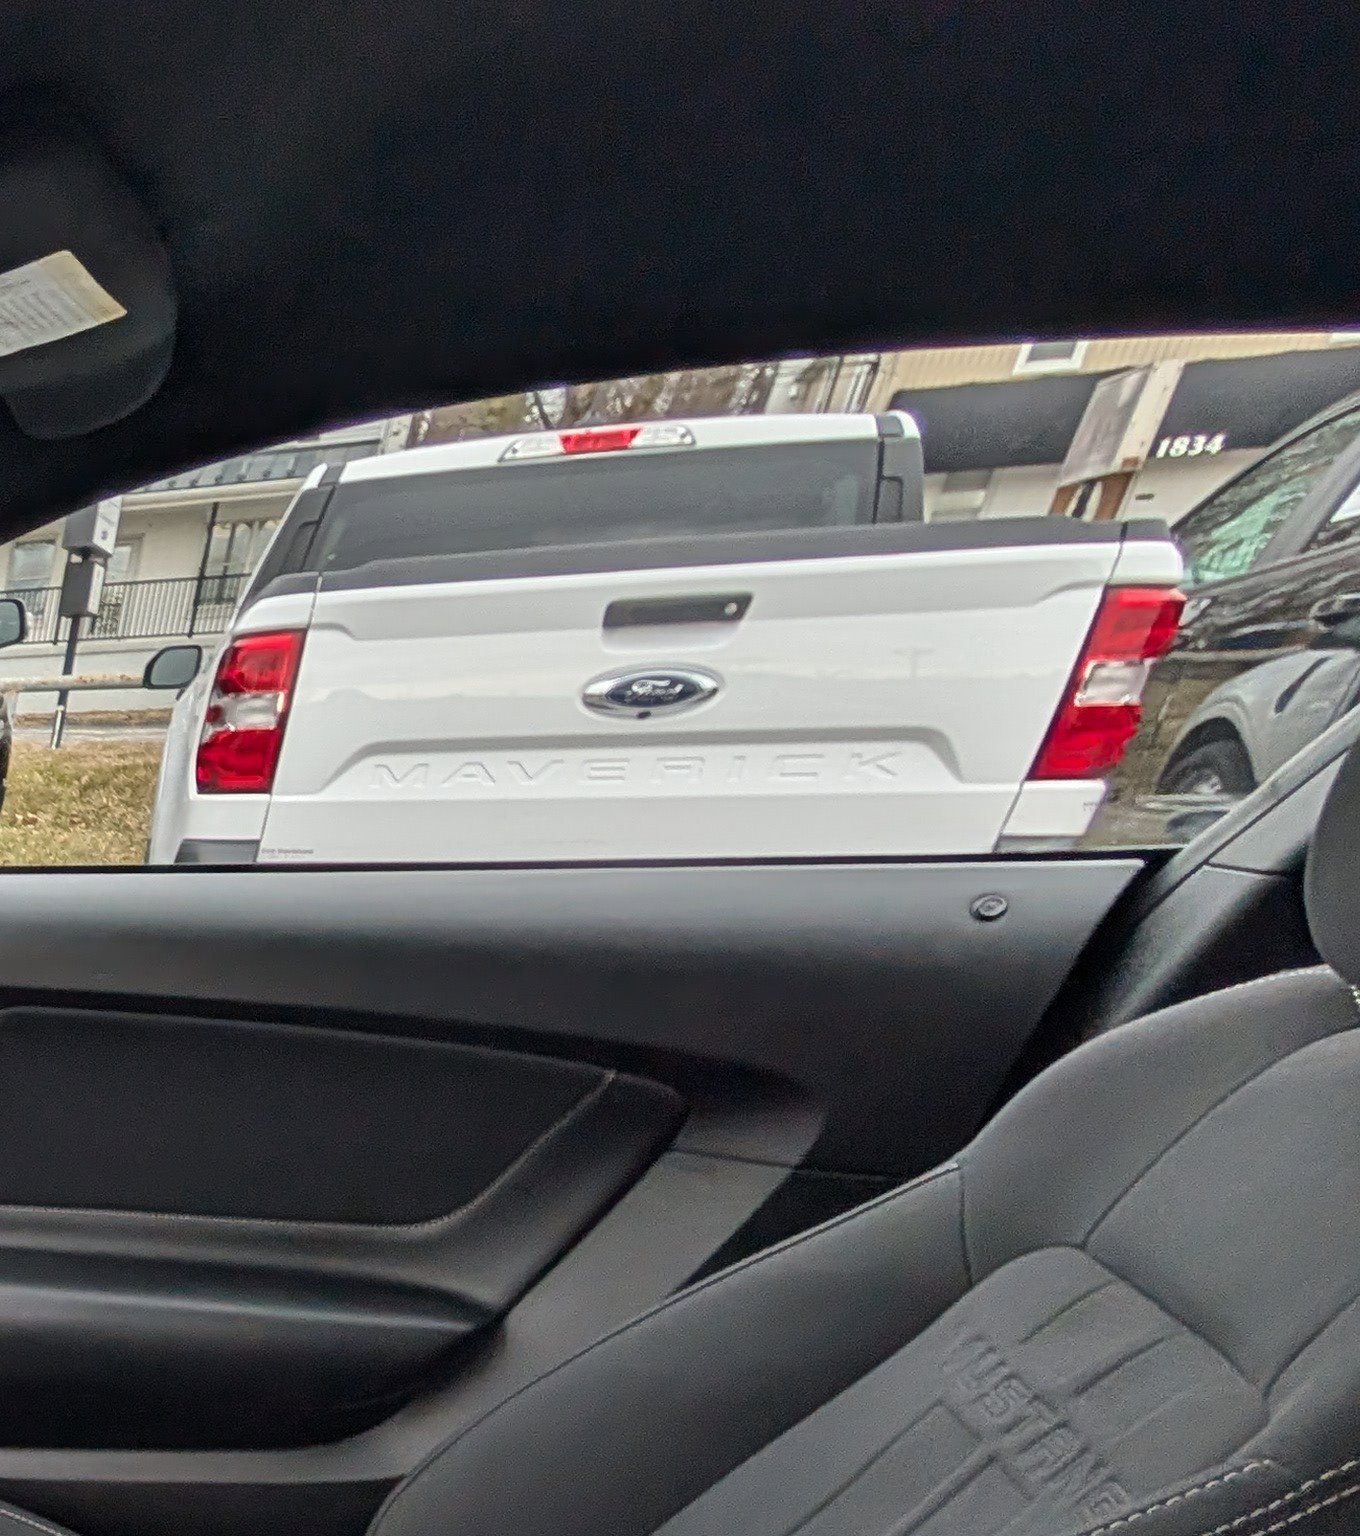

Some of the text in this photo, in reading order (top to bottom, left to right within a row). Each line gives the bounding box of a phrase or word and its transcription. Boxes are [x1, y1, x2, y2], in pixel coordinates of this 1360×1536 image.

[1156, 433, 1227, 459] 1834
[368, 751, 904, 790] MAVERICK
[936, 1322, 1132, 1523] MUSTANG
